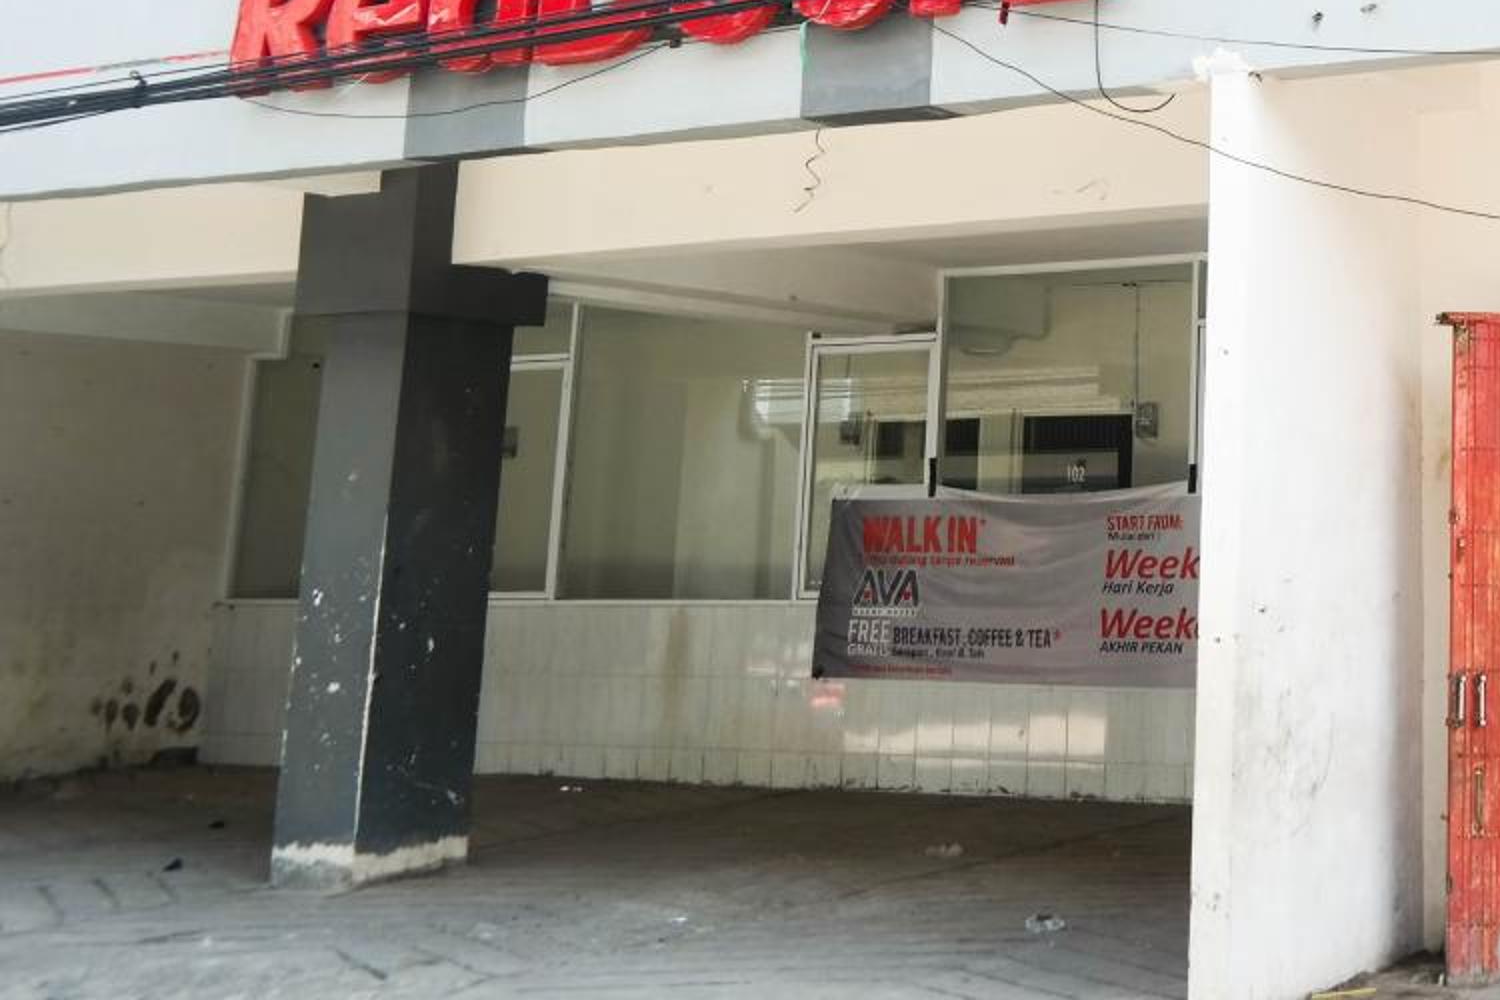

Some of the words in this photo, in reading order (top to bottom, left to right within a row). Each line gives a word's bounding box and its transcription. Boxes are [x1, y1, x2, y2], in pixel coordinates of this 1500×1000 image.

[1067, 464, 1086, 482] 102
[1107, 515, 1145, 531] START
[863, 515, 942, 552] WALK
[852, 567, 921, 607] AVA
[1102, 580, 1134, 594] Hari
[1136, 581, 1175, 597] Kerja
[847, 619, 891, 643] FREE
[968, 627, 1013, 648] COFFEE
[1015, 629, 1025, 648] &
[1100, 641, 1138, 654] AKHIR
[1141, 641, 1183, 654] PEKAN
